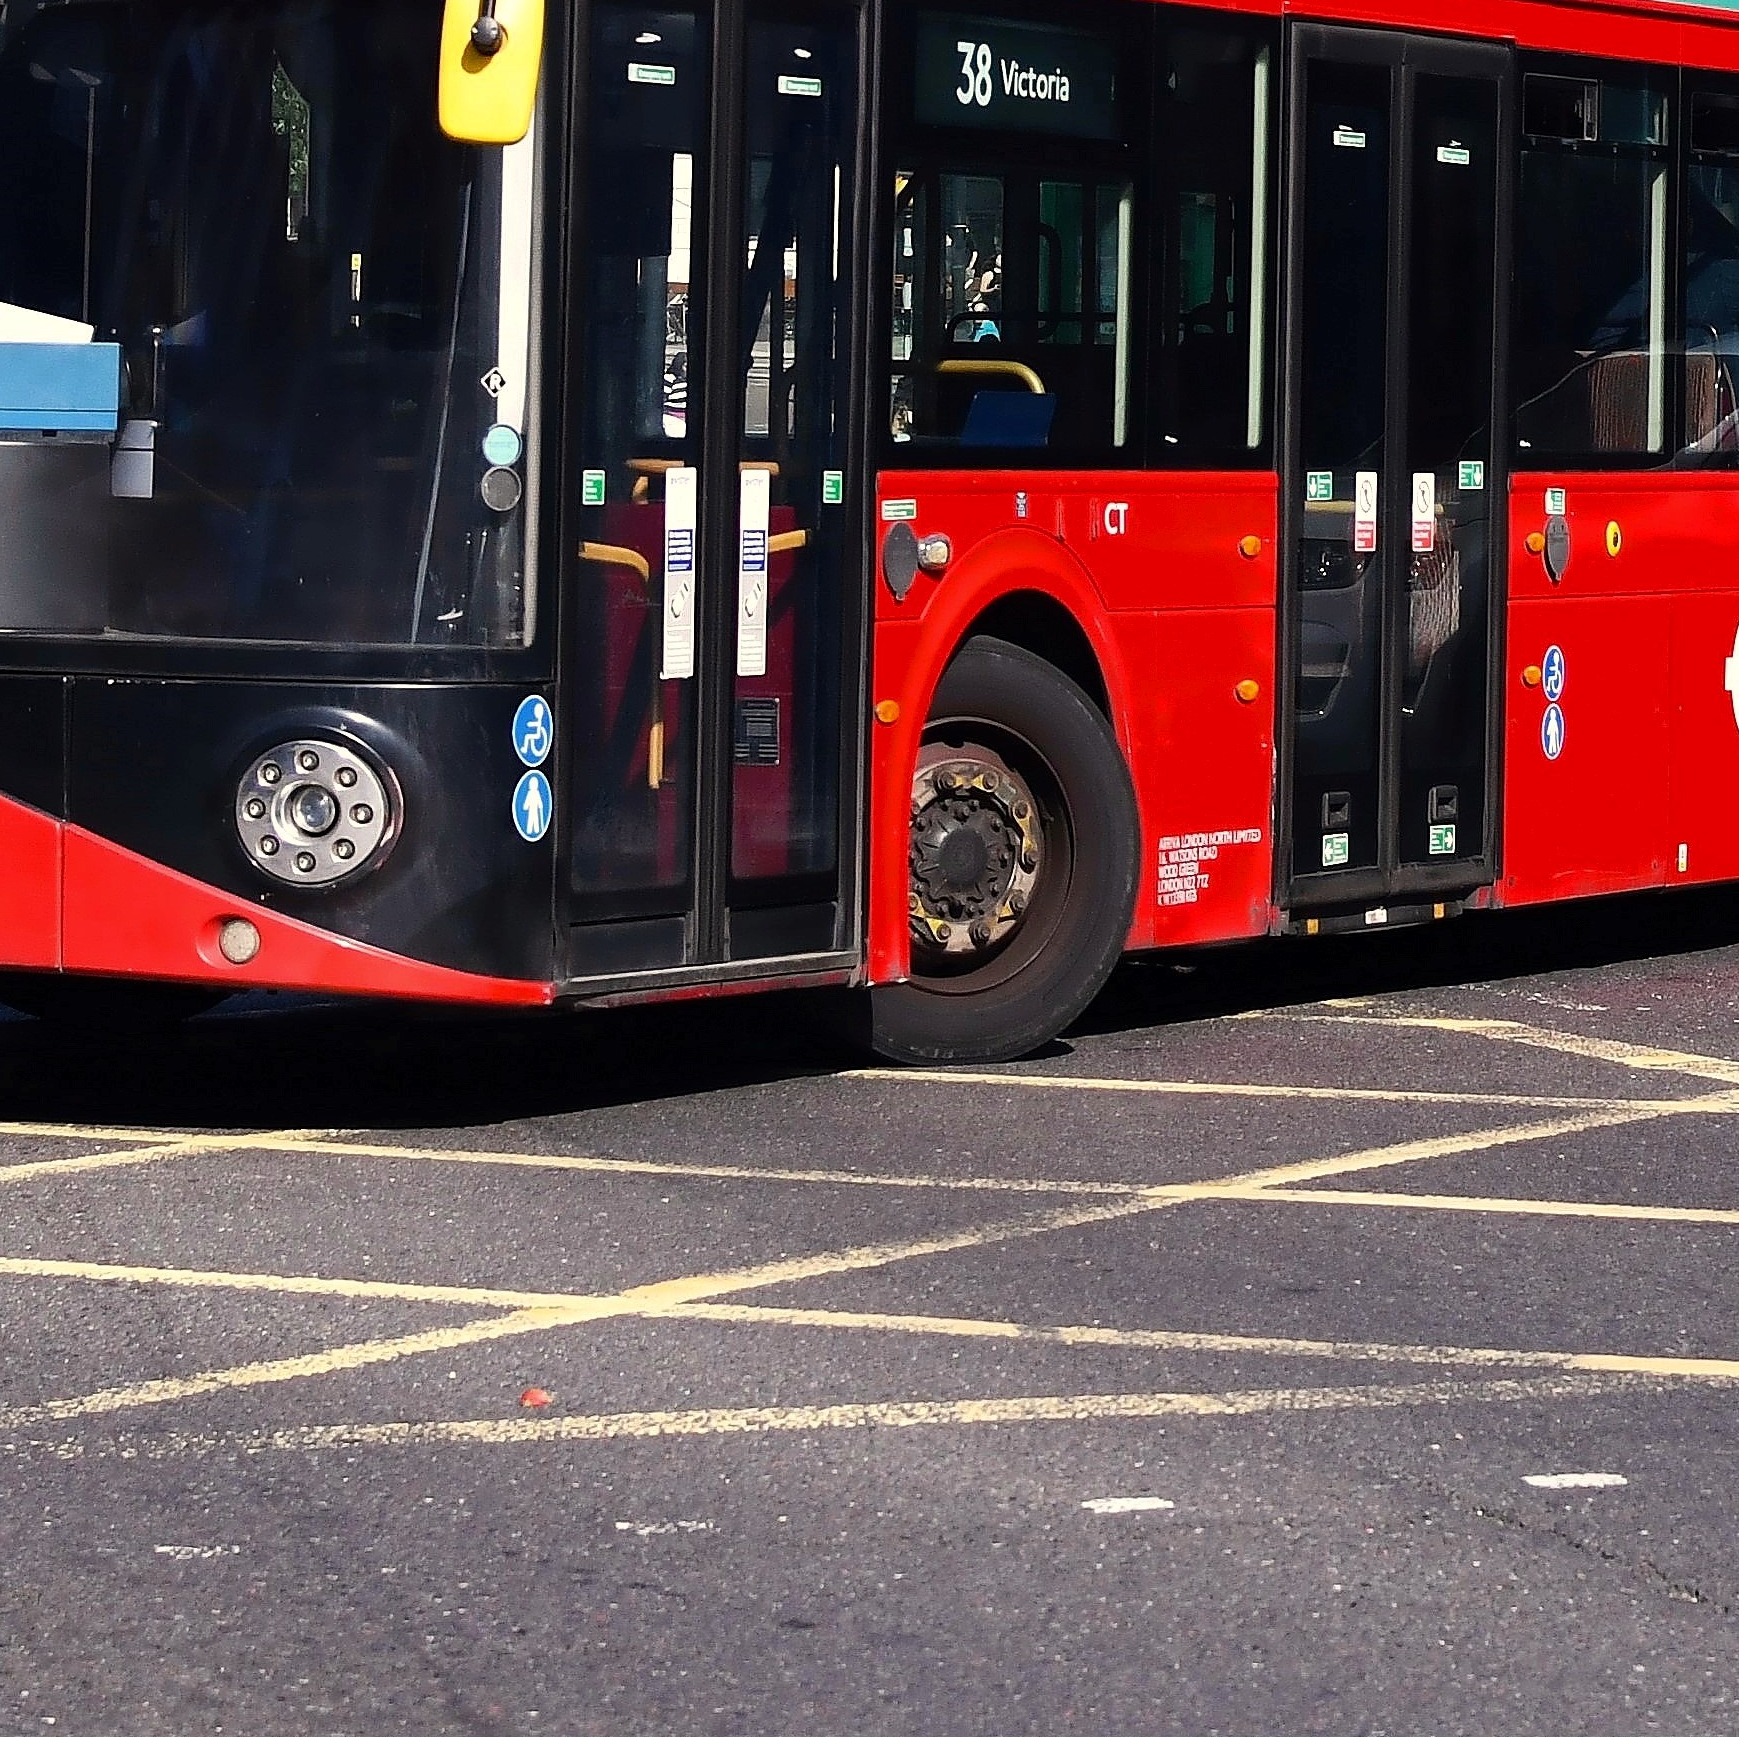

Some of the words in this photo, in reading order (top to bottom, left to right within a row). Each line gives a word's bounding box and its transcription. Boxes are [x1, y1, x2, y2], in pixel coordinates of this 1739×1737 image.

[956, 41, 992, 107] 38
[1000, 58, 1070, 103] Victoria
[1104, 502, 1129, 535] CT
